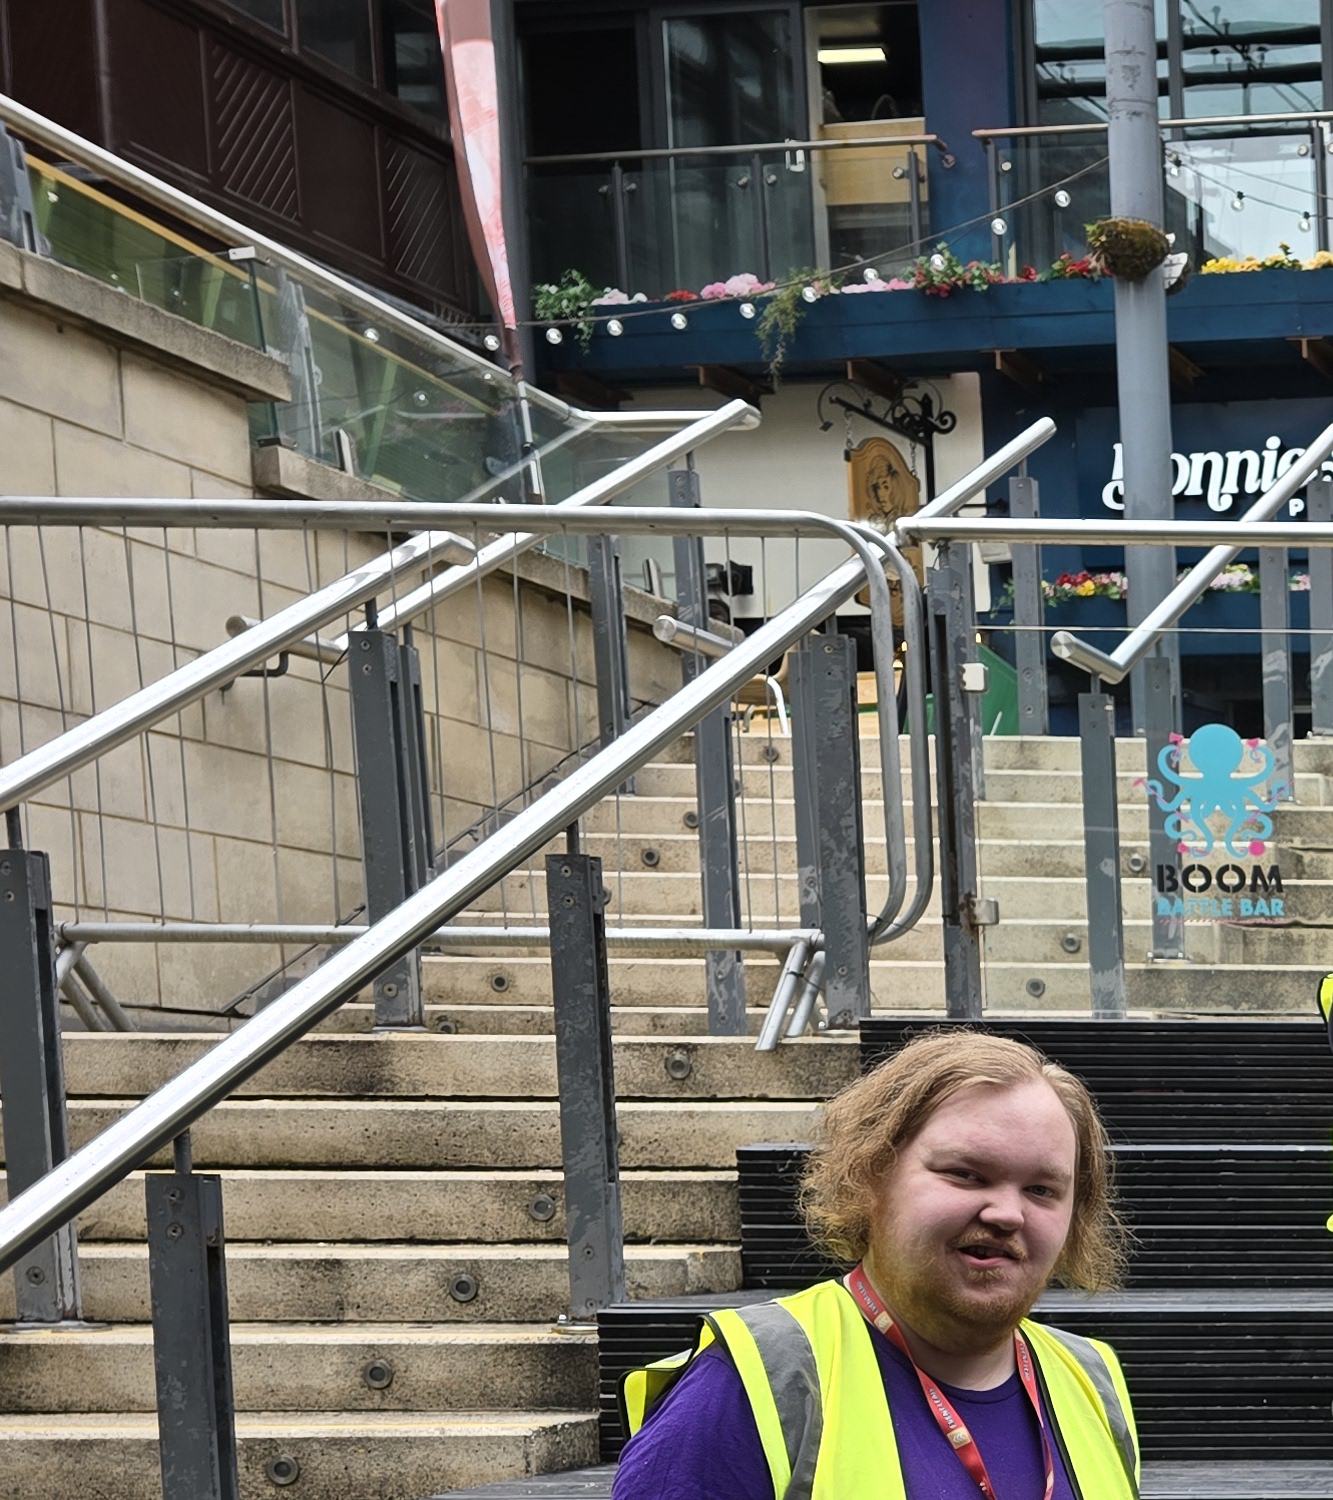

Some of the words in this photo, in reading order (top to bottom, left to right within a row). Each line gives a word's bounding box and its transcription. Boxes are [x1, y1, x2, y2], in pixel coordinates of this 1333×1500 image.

[1156, 863, 1284, 894] BOOM
[1157, 898, 1234, 917] BATTLE
[1240, 898, 1286, 917] BAR
